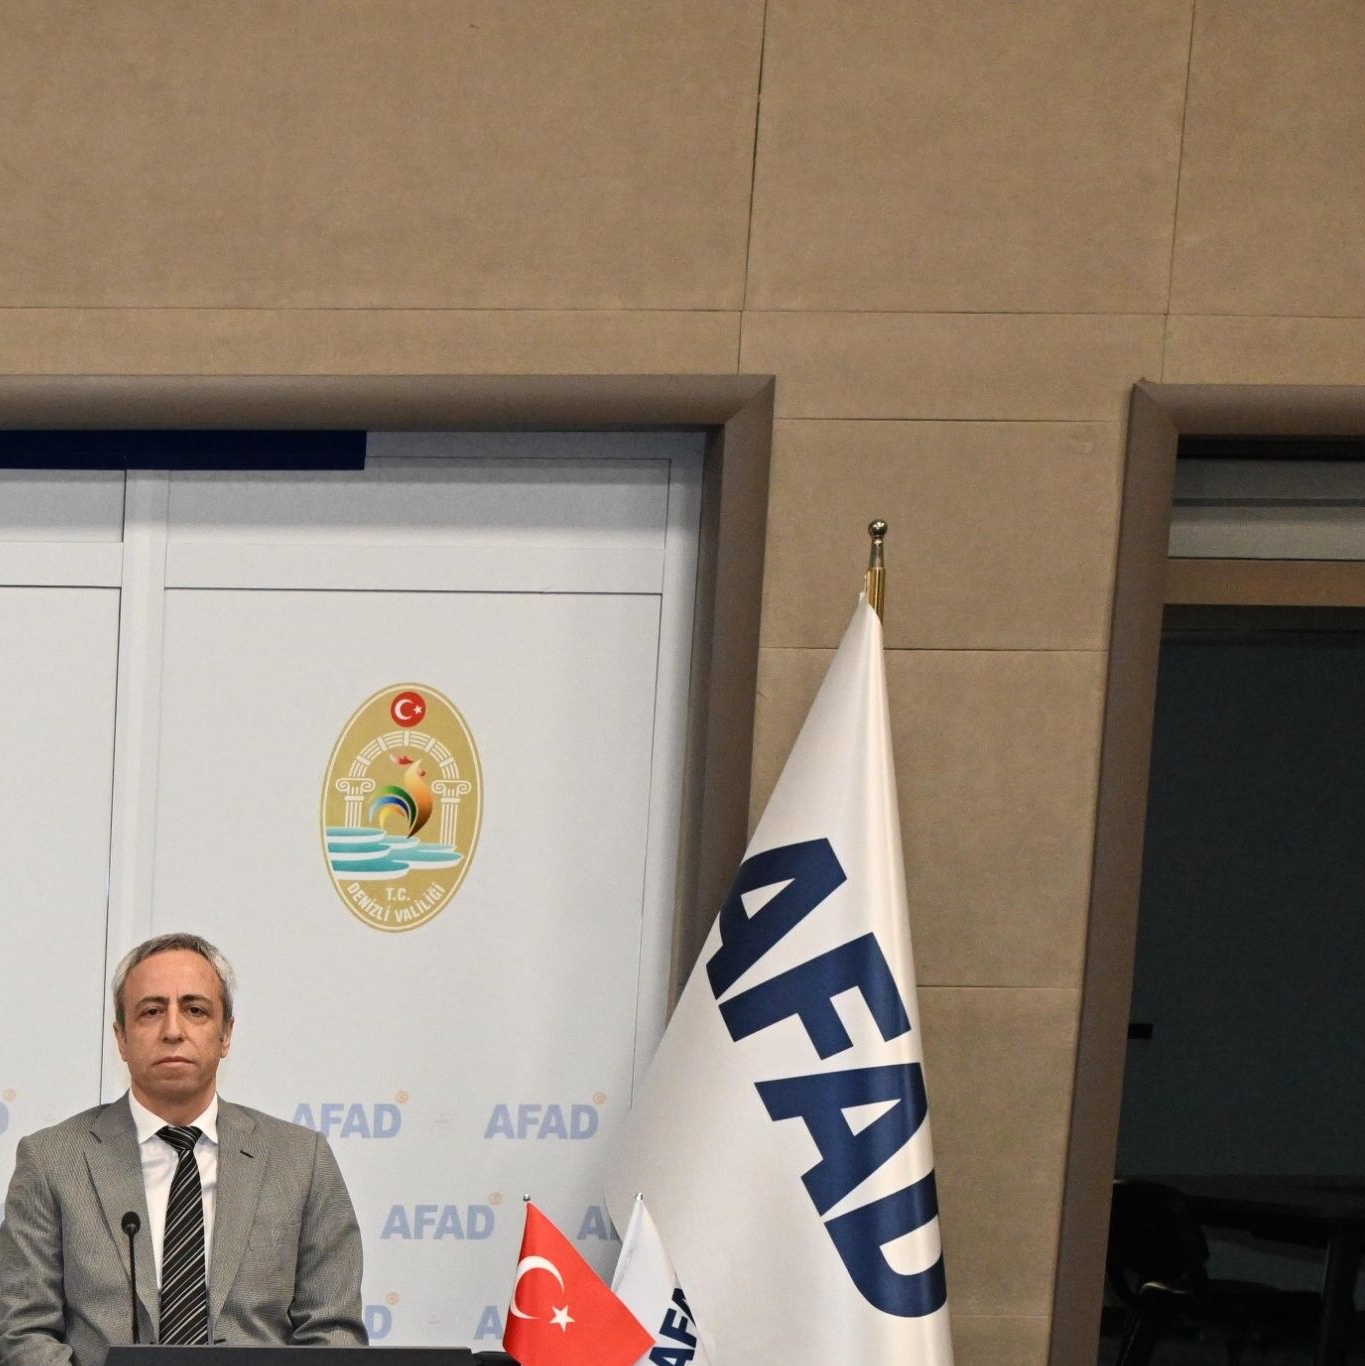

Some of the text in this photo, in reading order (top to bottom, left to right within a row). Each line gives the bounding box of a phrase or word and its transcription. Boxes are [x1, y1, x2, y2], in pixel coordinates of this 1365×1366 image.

[347, 881, 446, 923] DENİZLİ VALİLİĞİ
[386, 887, 411, 901] T.C.
[706, 838, 948, 1318] AFAD
[292, 1103, 402, 1138] AFAD
[484, 1104, 599, 1140] AFAD
[380, 1205, 496, 1240] AFAD
